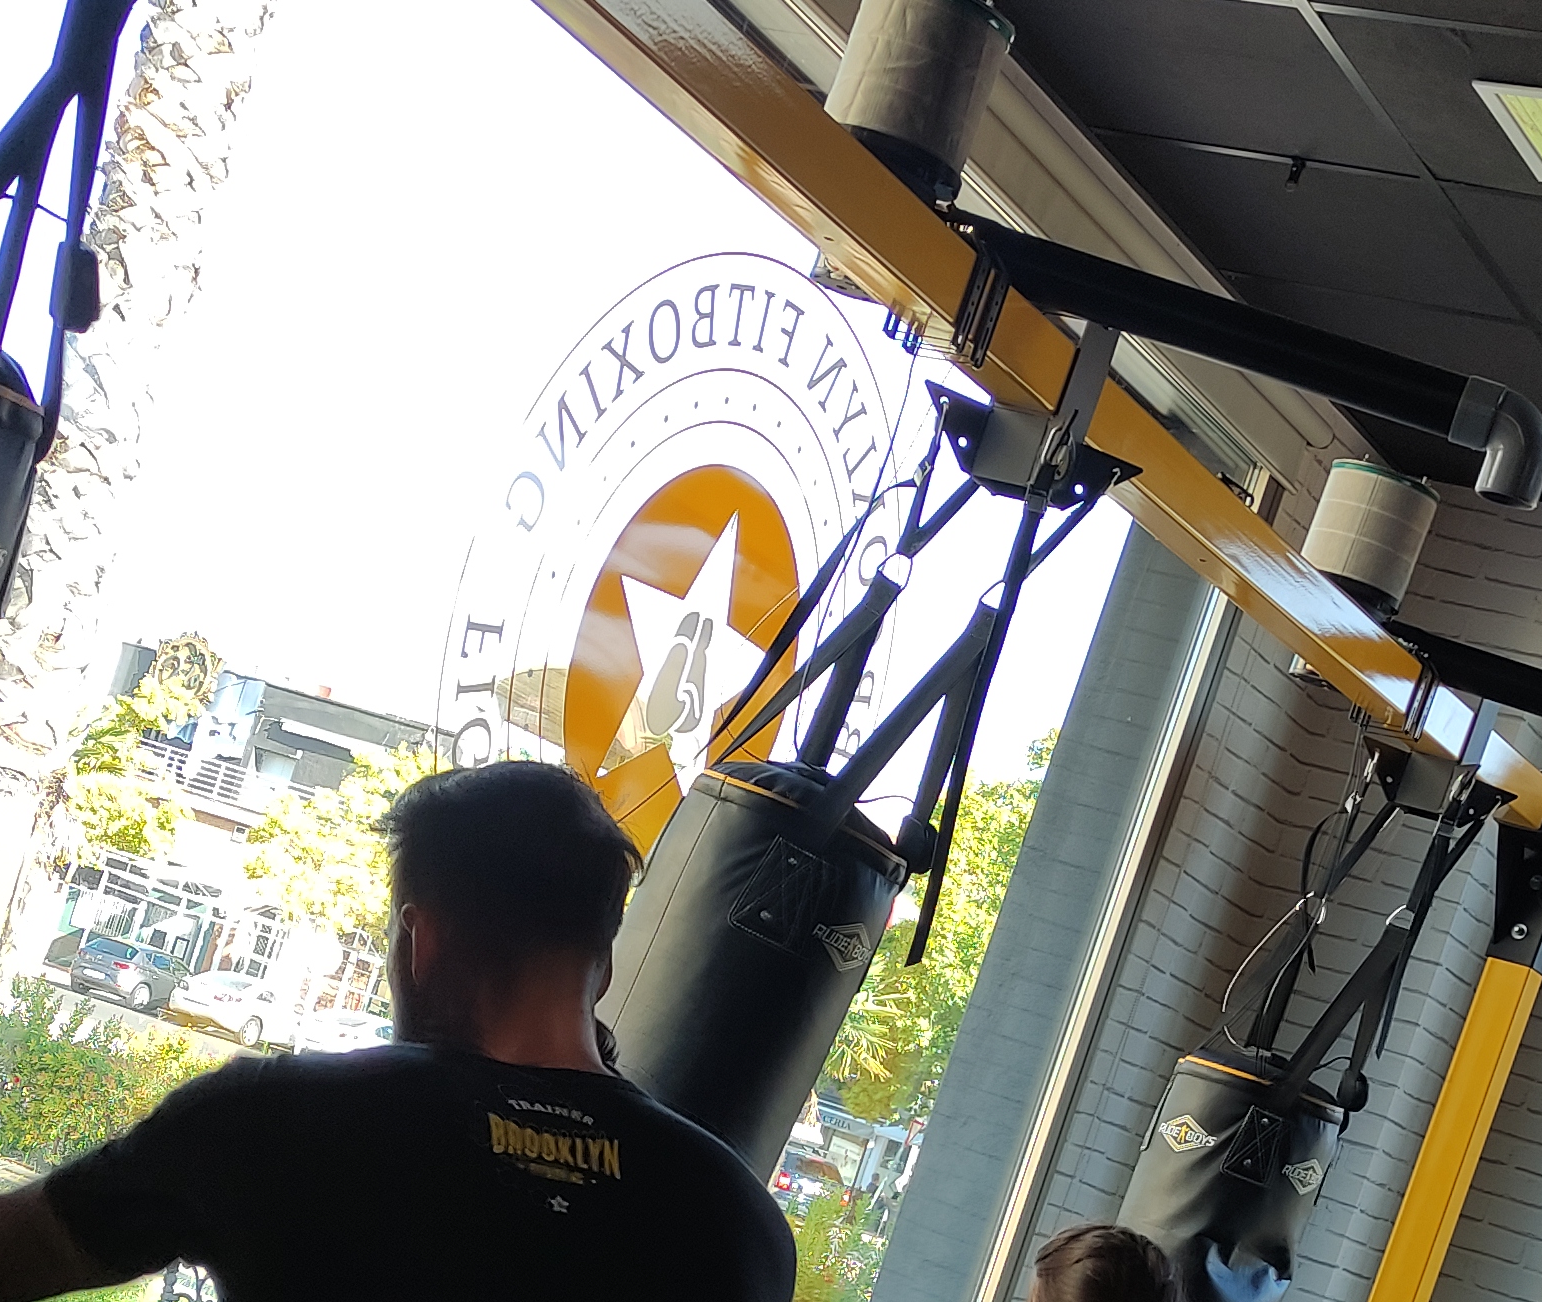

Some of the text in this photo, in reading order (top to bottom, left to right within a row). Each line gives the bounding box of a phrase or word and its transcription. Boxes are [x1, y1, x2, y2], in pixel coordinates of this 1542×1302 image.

[812, 923, 851, 952] RUDE
[487, 1111, 622, 1180] BROOKLYN
[1158, 1122, 1218, 1148] RUDE BOYS
[1281, 1164, 1307, 1181] RUDE
